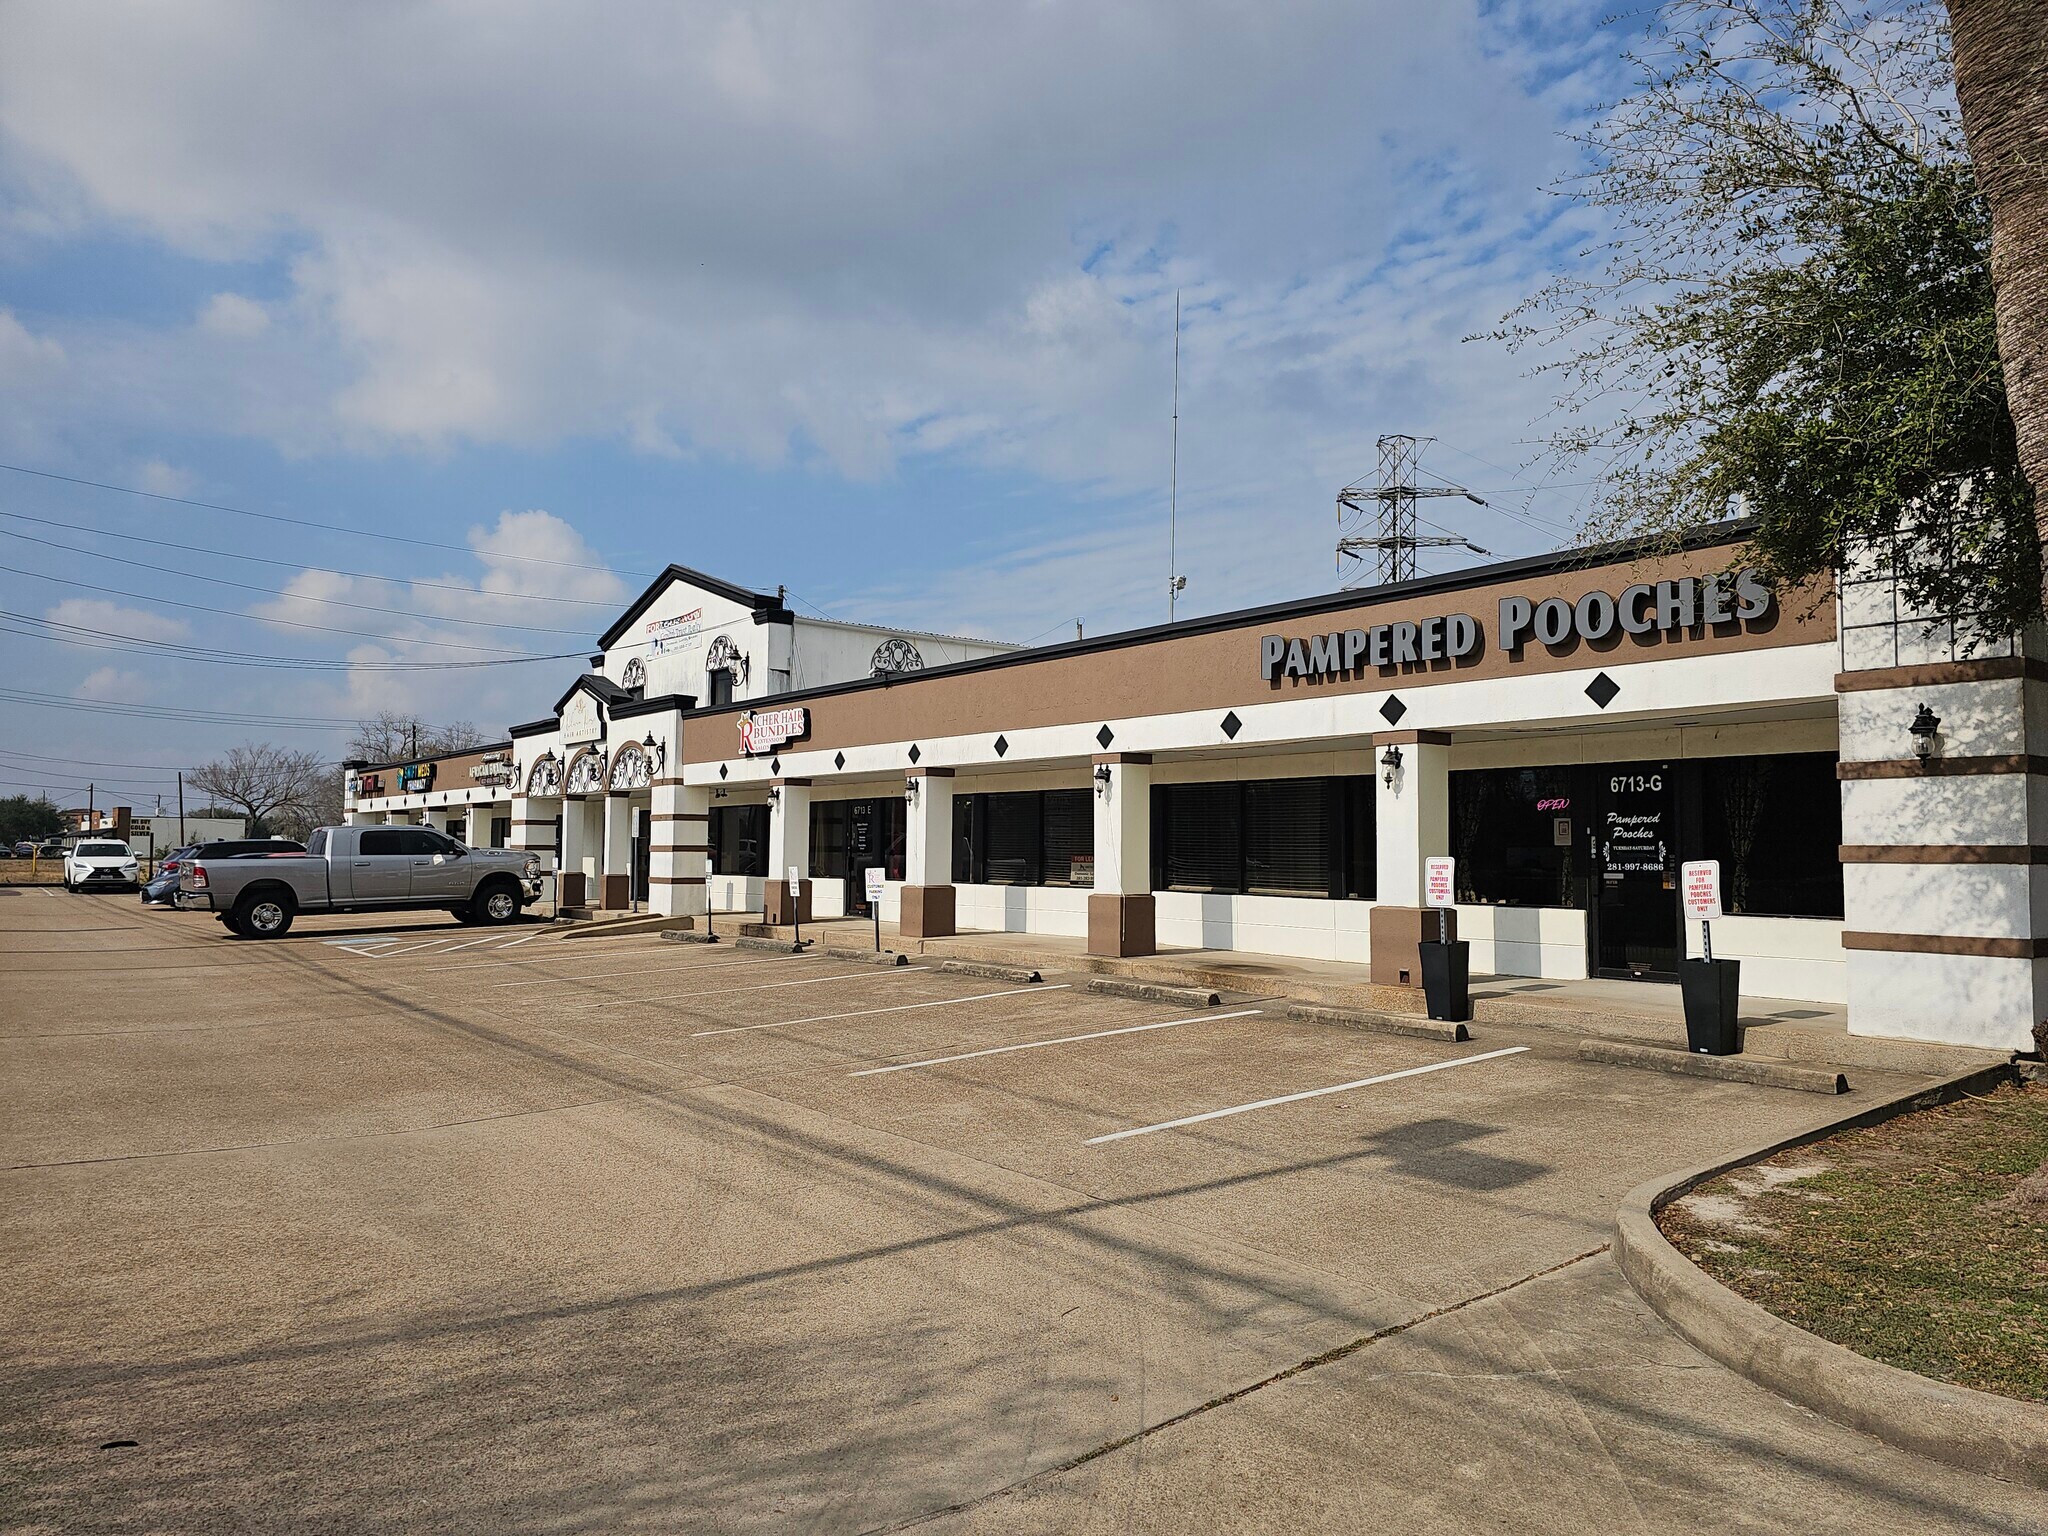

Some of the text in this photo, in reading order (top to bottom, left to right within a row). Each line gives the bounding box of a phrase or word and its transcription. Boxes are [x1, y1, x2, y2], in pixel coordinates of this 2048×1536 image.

[1262, 567, 1773, 680] PAMPERED POOCHES
[781, 710, 804, 724] HAIR
[754, 722, 804, 739] BUNDLES
[1610, 775, 1663, 793] 6713-G
[854, 806, 866, 815] 6713
[1537, 798, 1570, 811] OPEN
[1607, 812, 1661, 827] Pampered
[1613, 826, 1655, 839] Pooches
[1606, 863, 1664, 871] 281-997-8686
